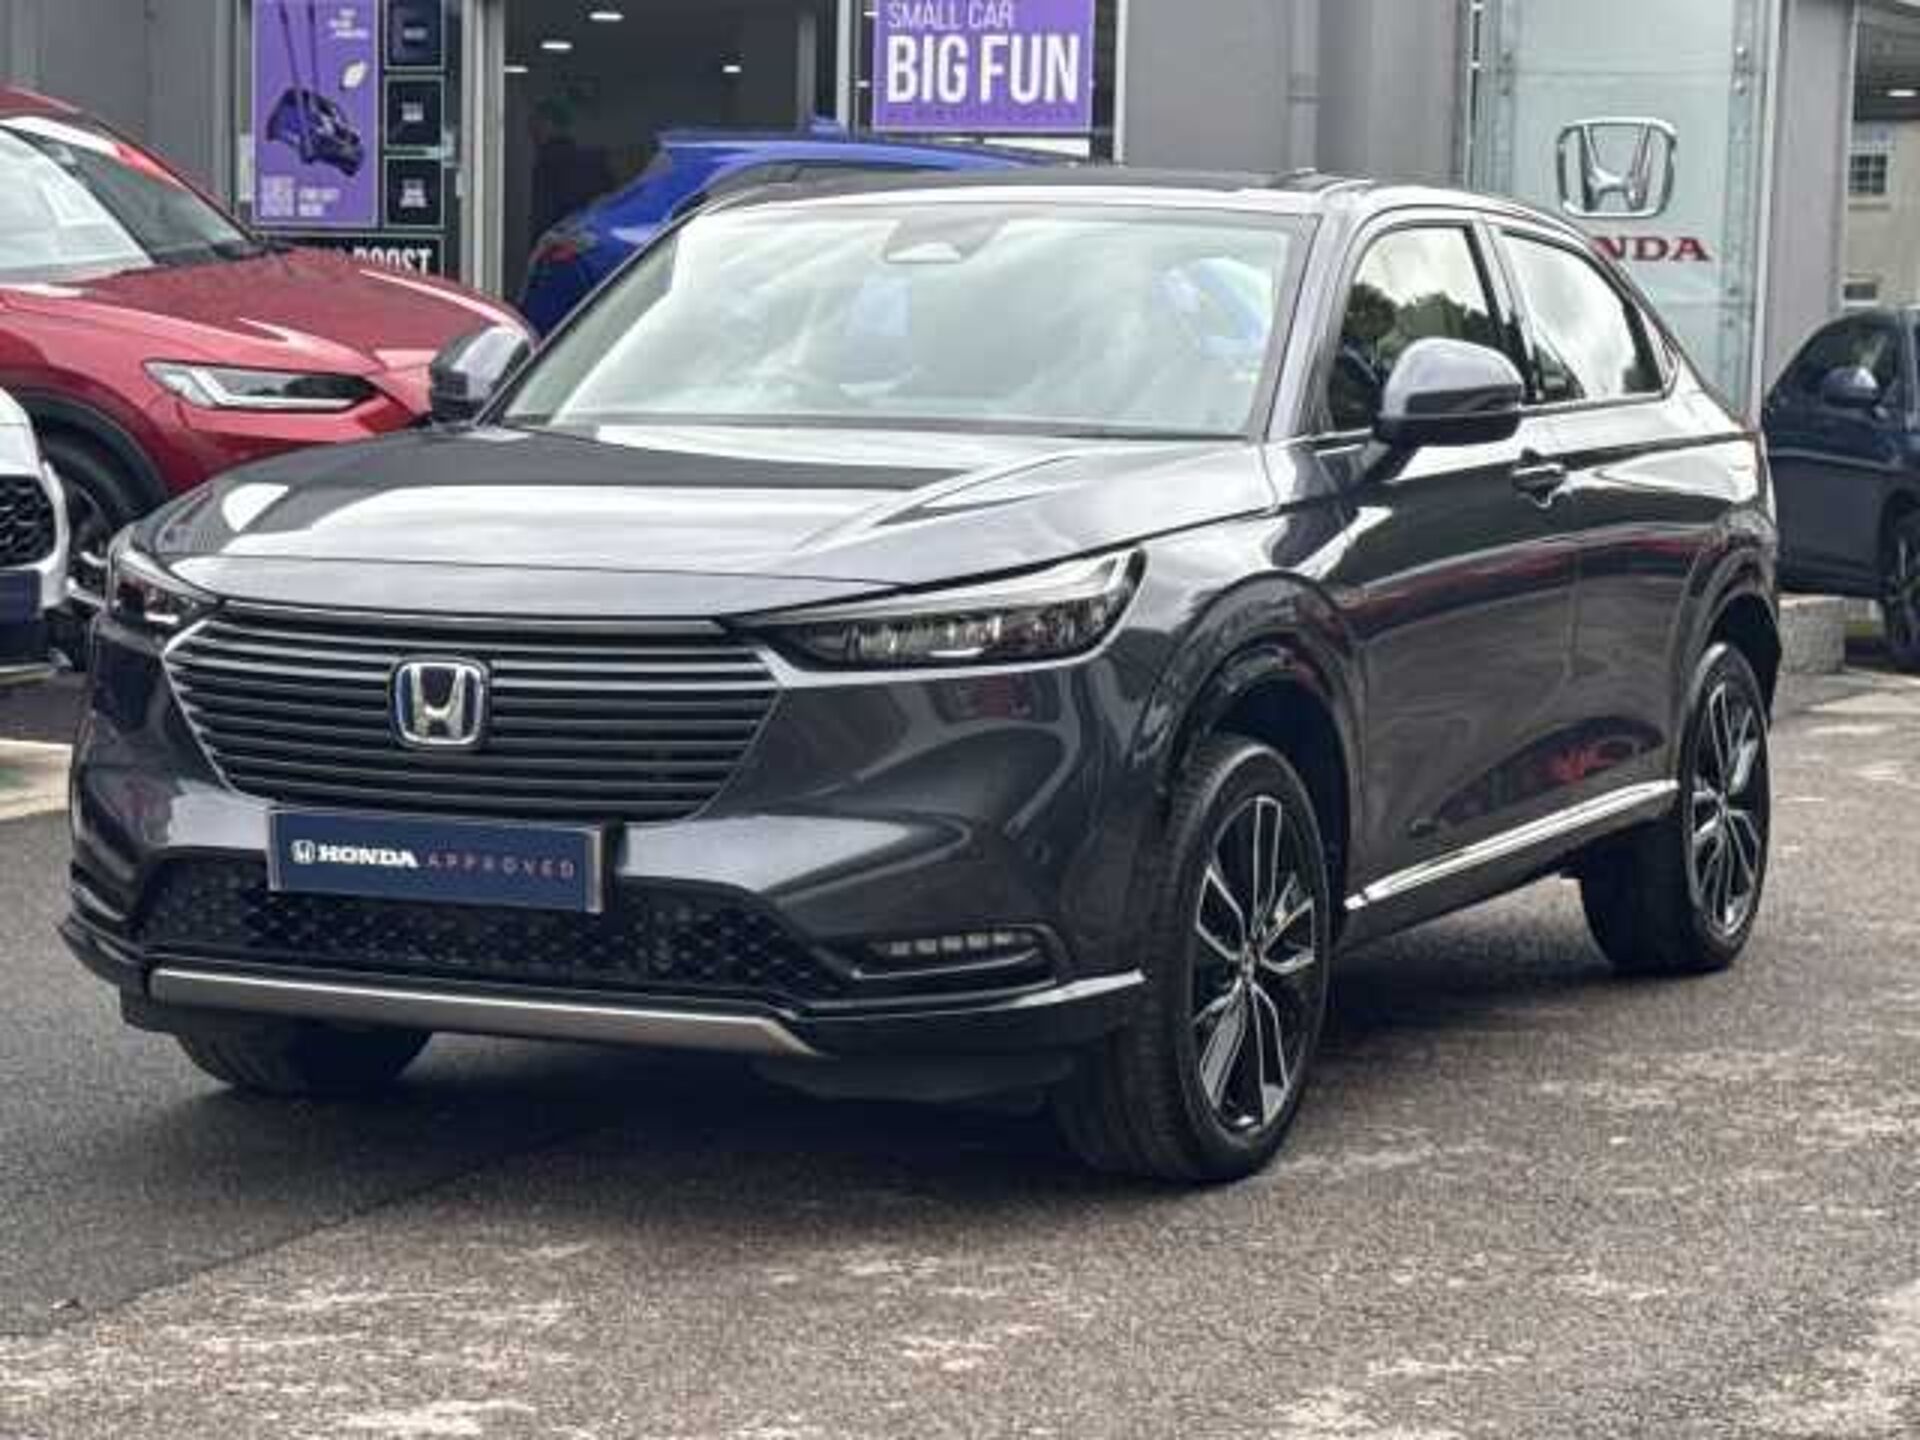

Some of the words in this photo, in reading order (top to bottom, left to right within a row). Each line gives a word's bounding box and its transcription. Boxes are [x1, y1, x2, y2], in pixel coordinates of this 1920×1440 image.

[888, 0, 961, 30] SMALL
[968, 0, 1014, 29] CAR
[887, 34, 968, 104] BIG
[980, 34, 1081, 104] FUN
[1592, 235, 1712, 262] NDA
[318, 844, 419, 868] HONDA
[427, 853, 575, 878] APPROVED
